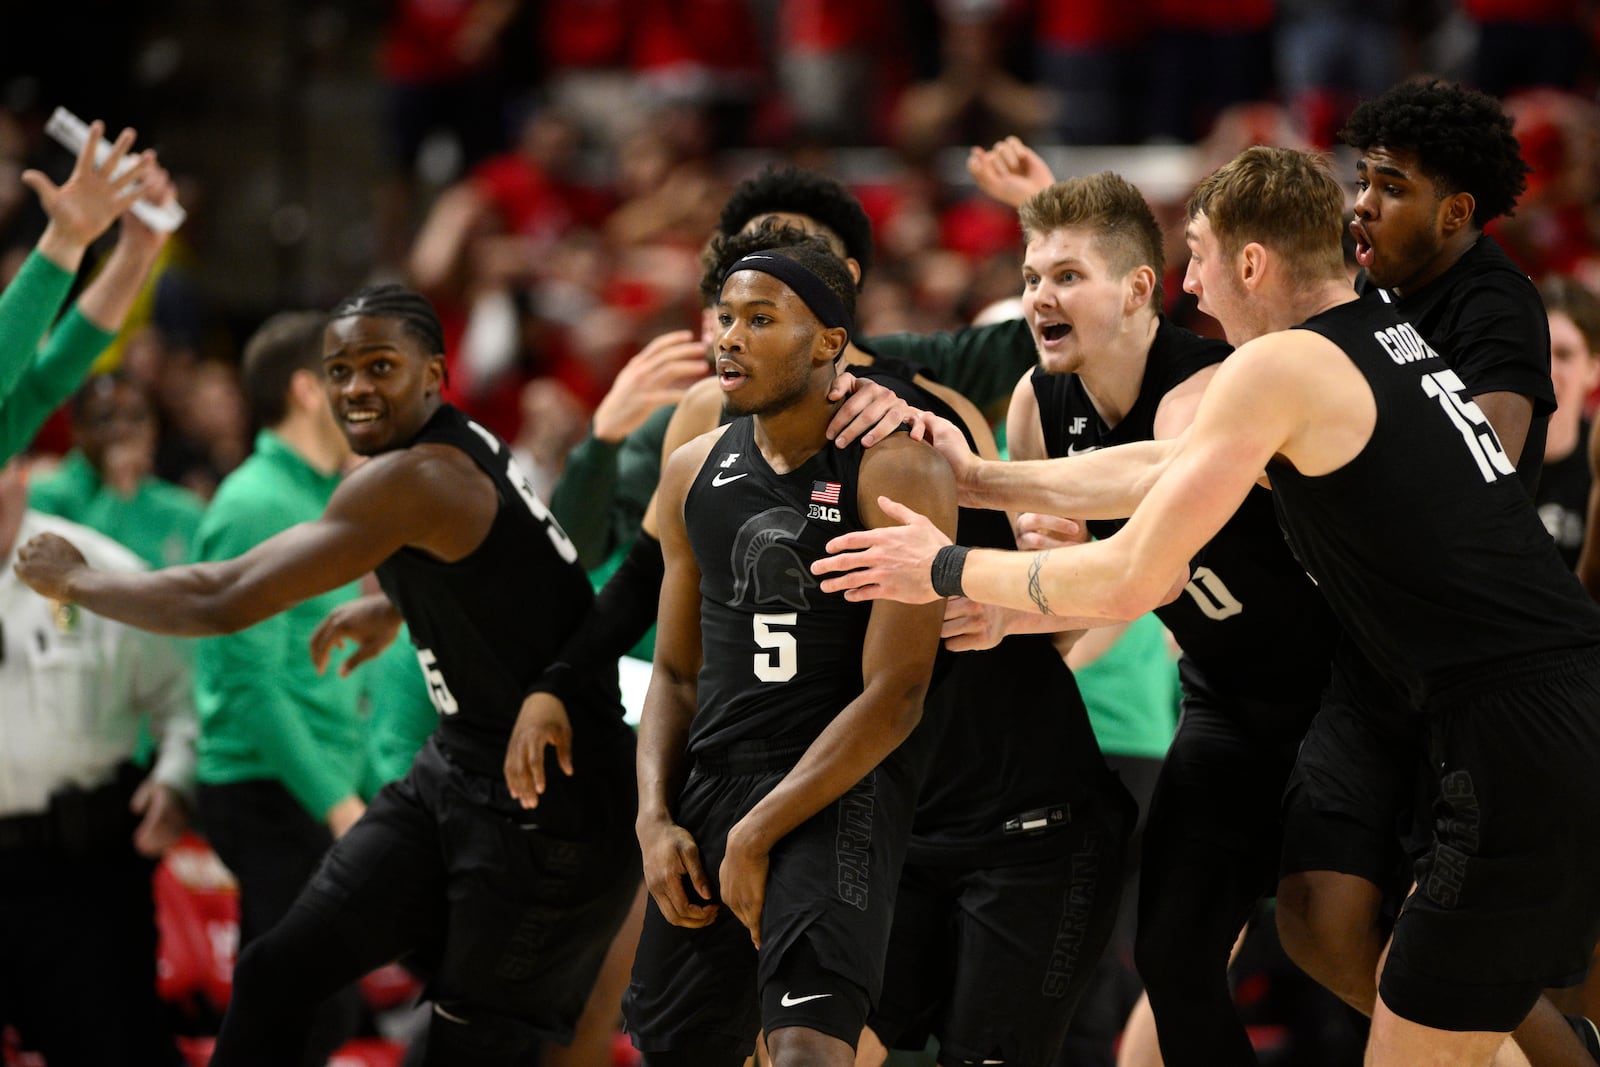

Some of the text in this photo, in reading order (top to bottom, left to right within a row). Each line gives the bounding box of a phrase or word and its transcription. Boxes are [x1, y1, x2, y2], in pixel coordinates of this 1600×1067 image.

[1068, 416, 1088, 435] JF
[1420, 368, 1517, 483] 15
[719, 452, 740, 468] JF
[1184, 565, 1244, 621] 0
[752, 612, 798, 683] 5
[836, 769, 877, 912] SPARTAN
